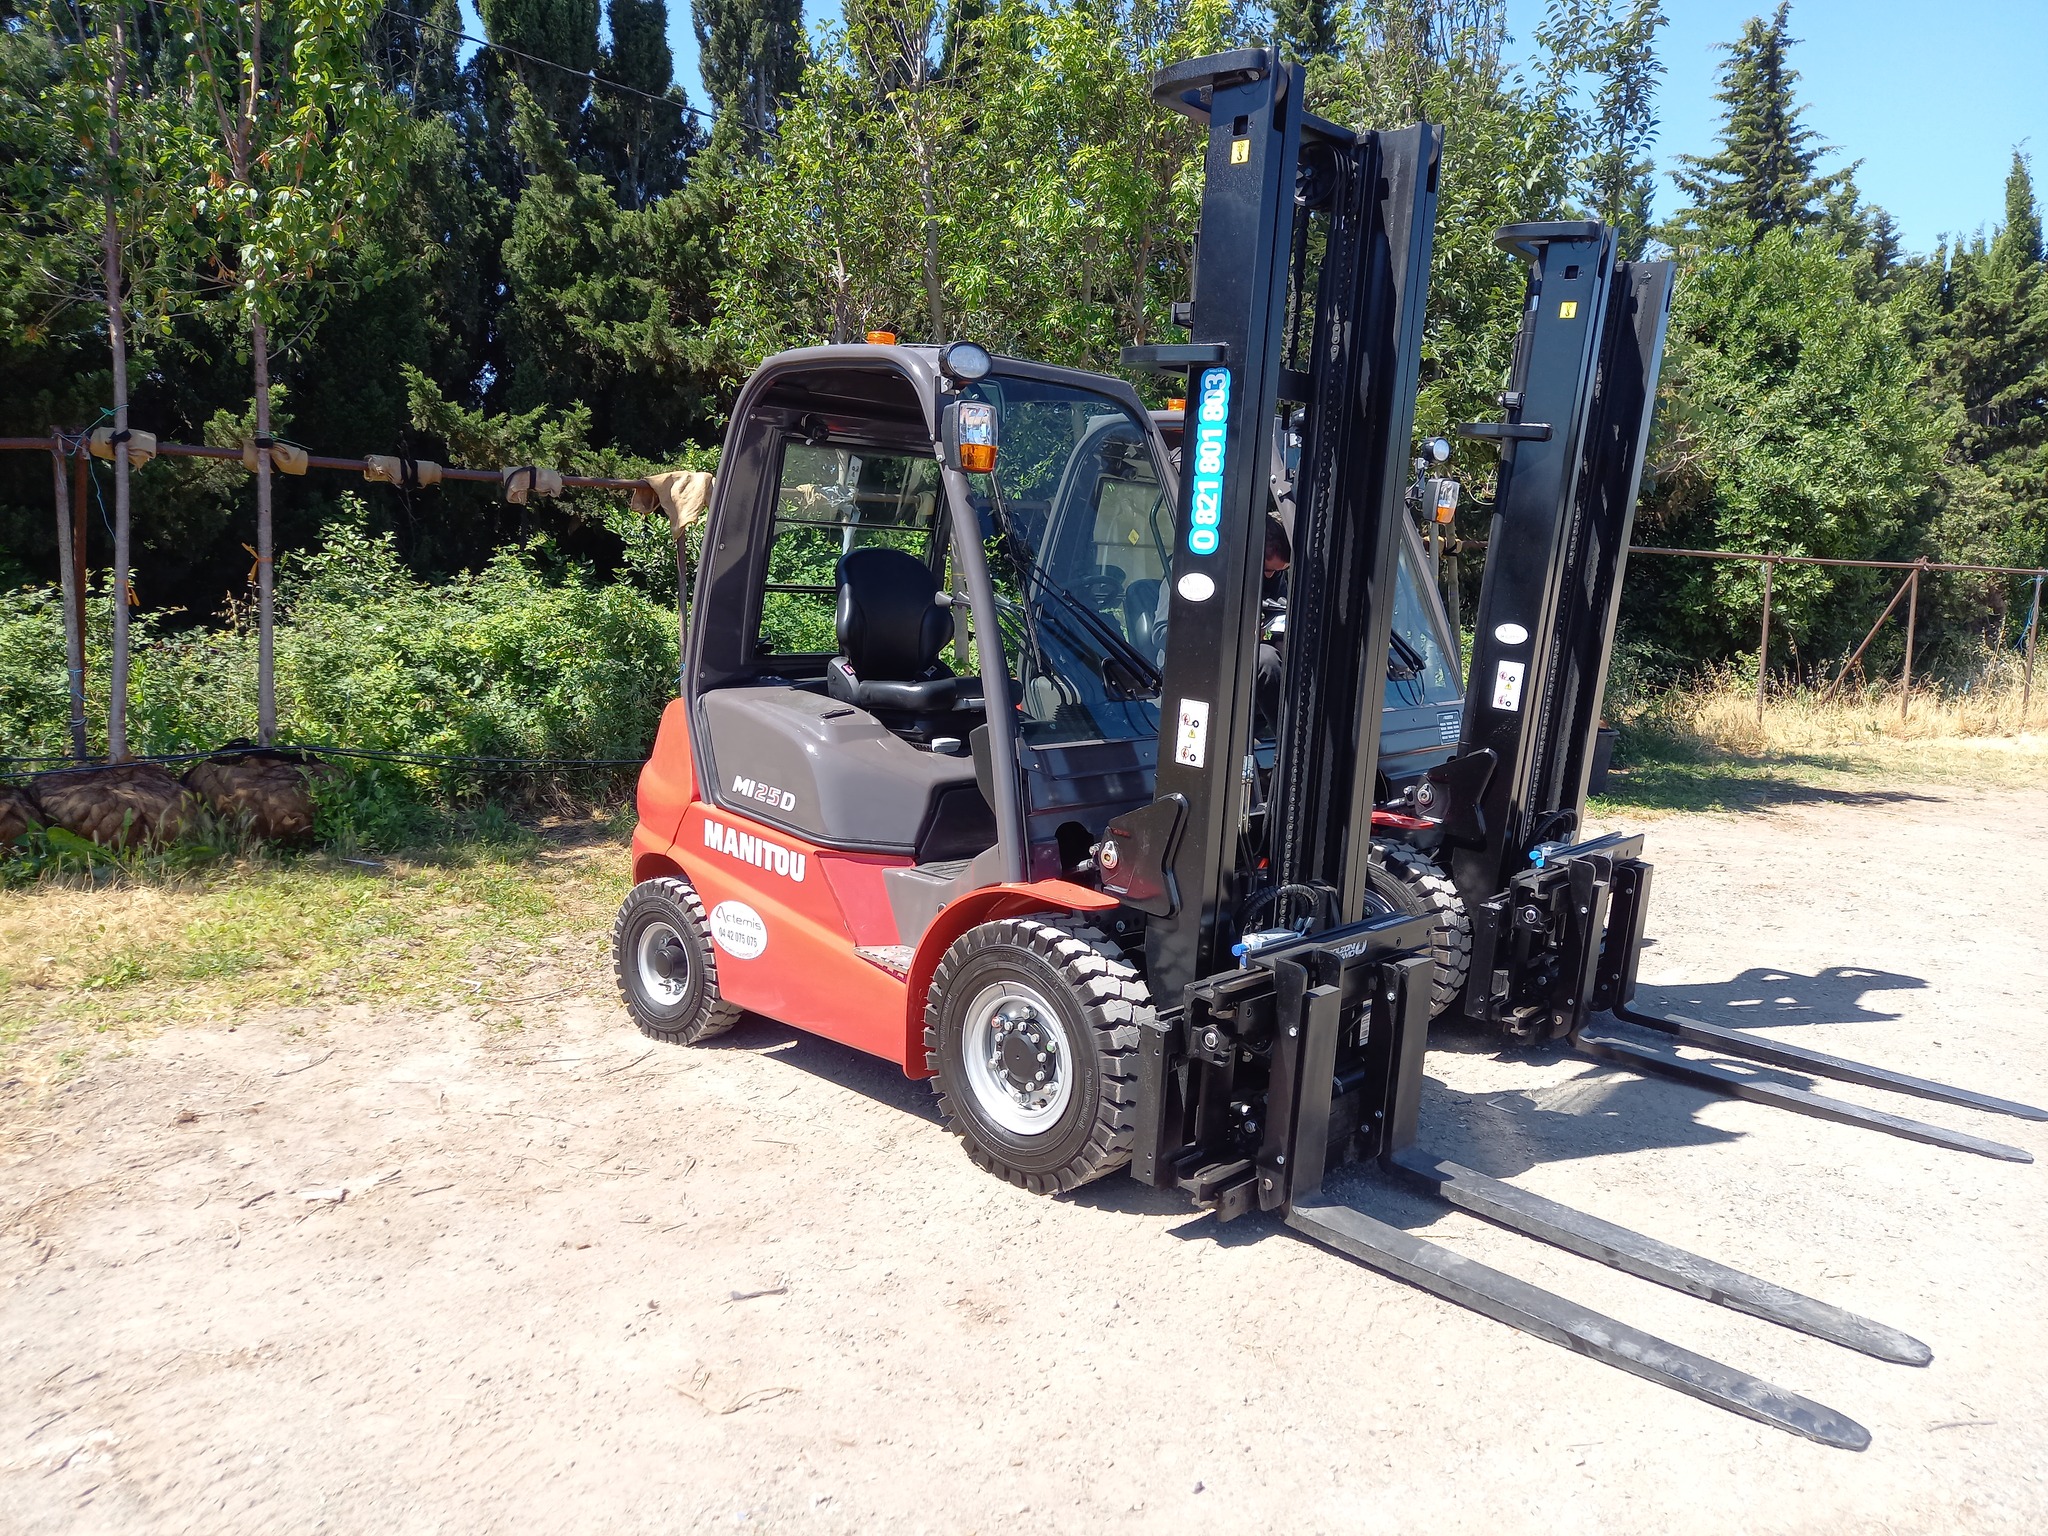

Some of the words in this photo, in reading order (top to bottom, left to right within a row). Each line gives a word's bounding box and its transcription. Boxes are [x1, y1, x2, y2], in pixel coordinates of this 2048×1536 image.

[1202, 373, 1227, 422] 803
[1198, 429, 1223, 474] 801
[1195, 480, 1219, 525] 821
[1192, 529, 1215, 550] 0
[732, 775, 796, 811] MI25D
[704, 819, 806, 882] MANITOU
[718, 926, 726, 937] 04
[727, 930, 734, 941] 42
[735, 931, 745, 944] 075
[746, 935, 758, 948] 075
